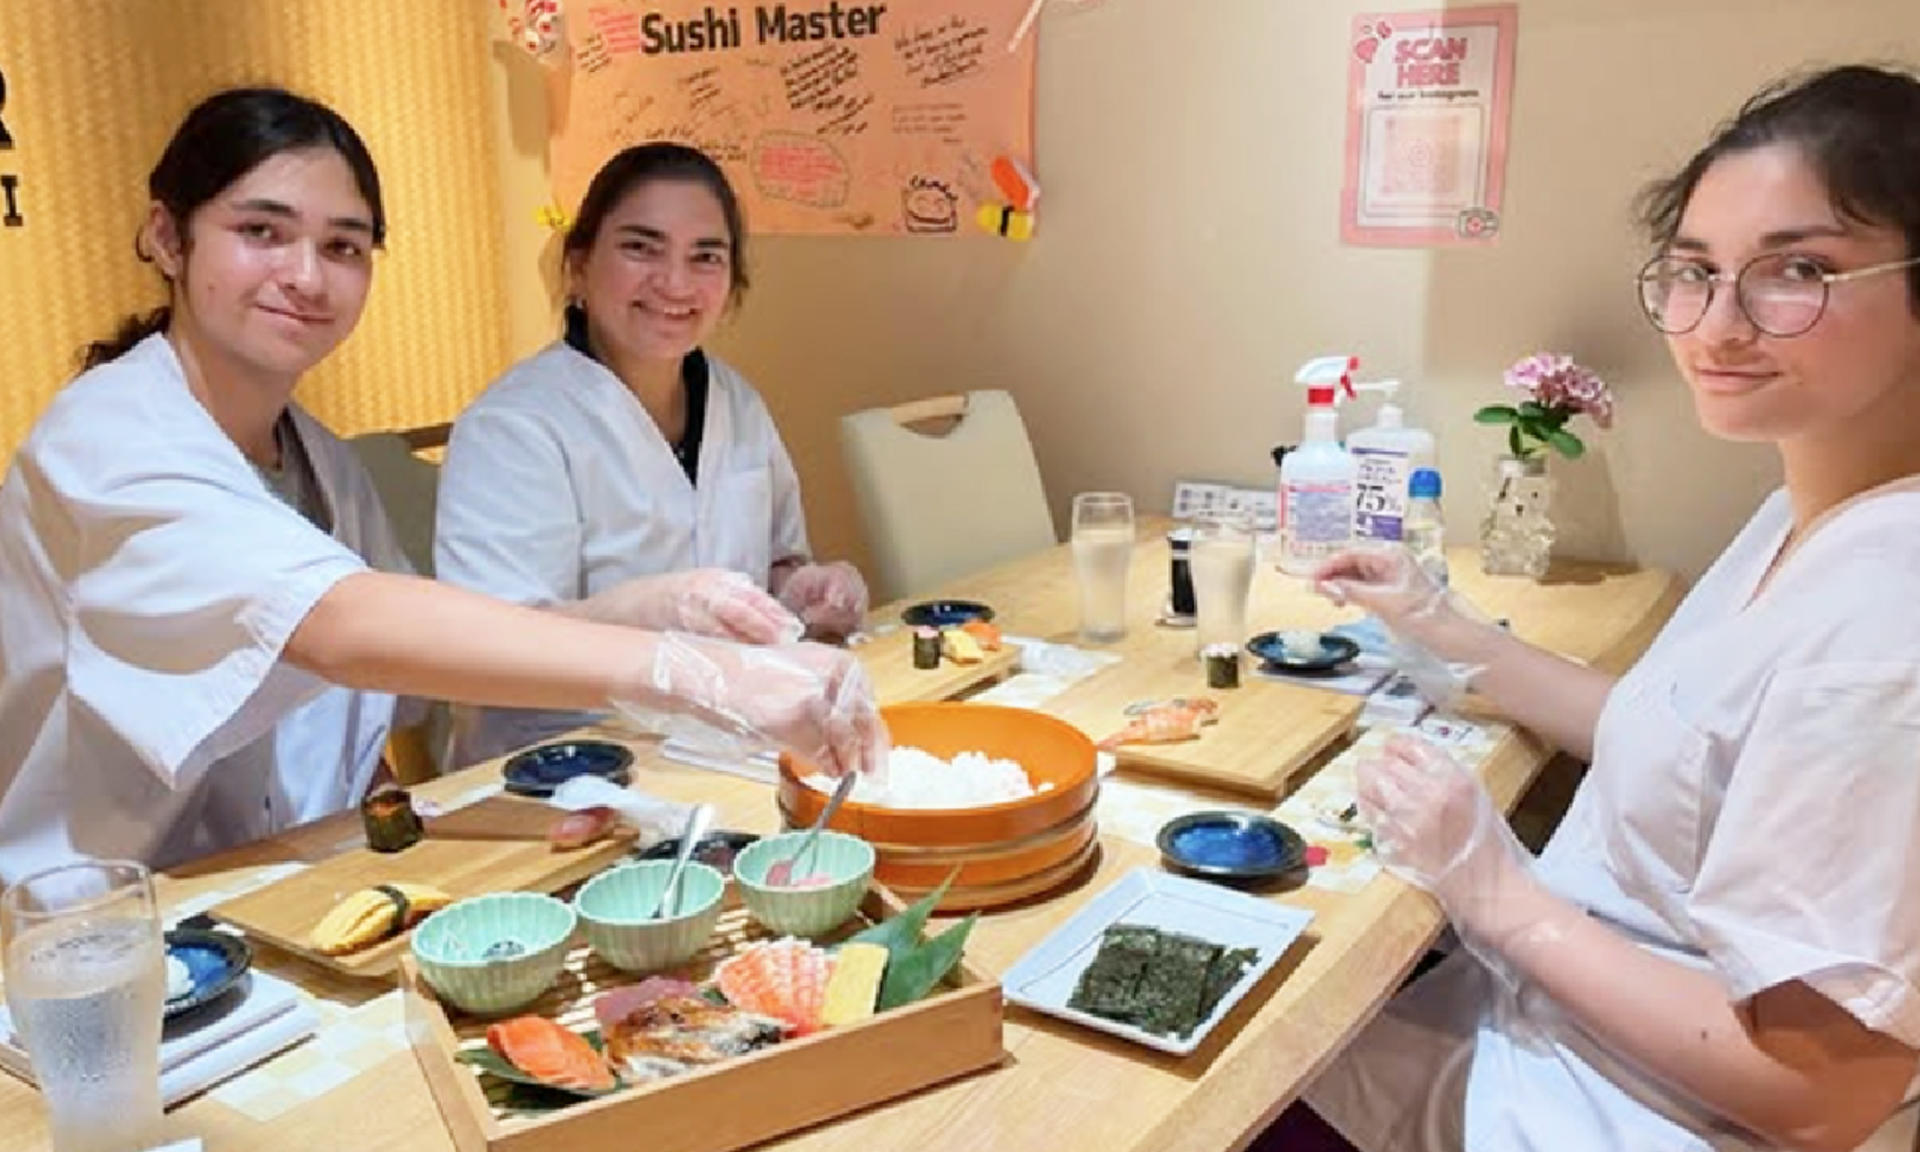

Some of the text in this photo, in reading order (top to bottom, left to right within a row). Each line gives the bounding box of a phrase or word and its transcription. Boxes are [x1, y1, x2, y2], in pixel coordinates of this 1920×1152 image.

[641, 7, 741, 54] Sushi
[754, 1, 887, 45] Master
[1394, 37, 1468, 63] SCAN
[1396, 63, 1460, 87] HERE
